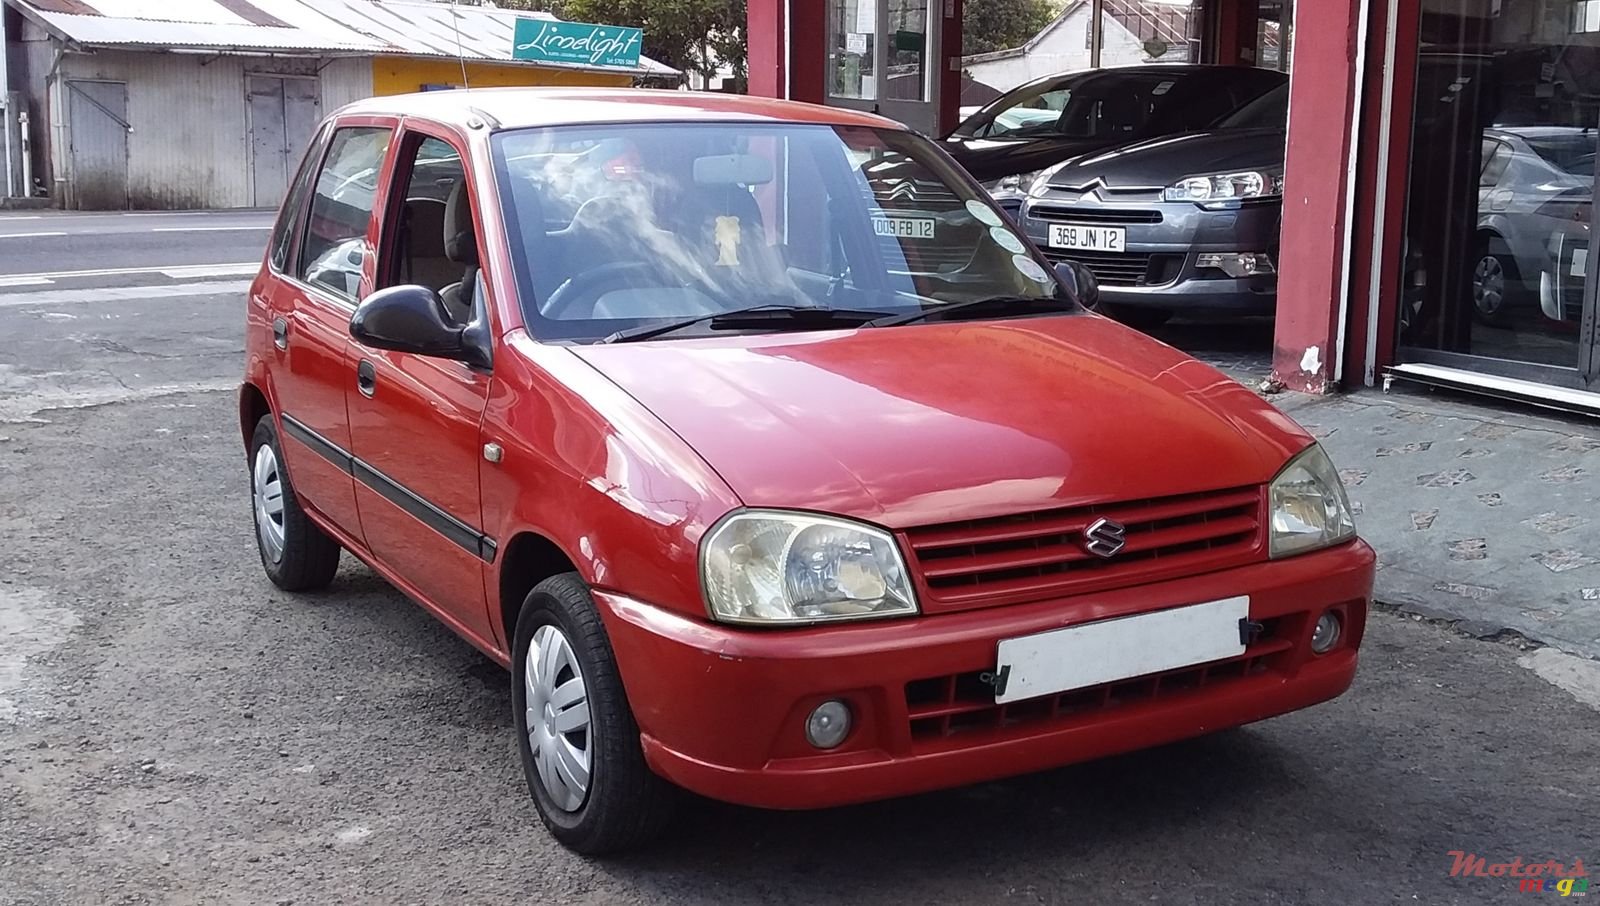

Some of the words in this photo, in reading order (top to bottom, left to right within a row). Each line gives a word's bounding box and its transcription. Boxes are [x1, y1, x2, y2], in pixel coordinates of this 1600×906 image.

[516, 22, 640, 63] Limelight
[899, 220, 913, 236] FB
[918, 221, 932, 237] 12
[1056, 227, 1077, 246] 369
[1081, 228, 1097, 247] JN
[1103, 229, 1118, 249] 12
